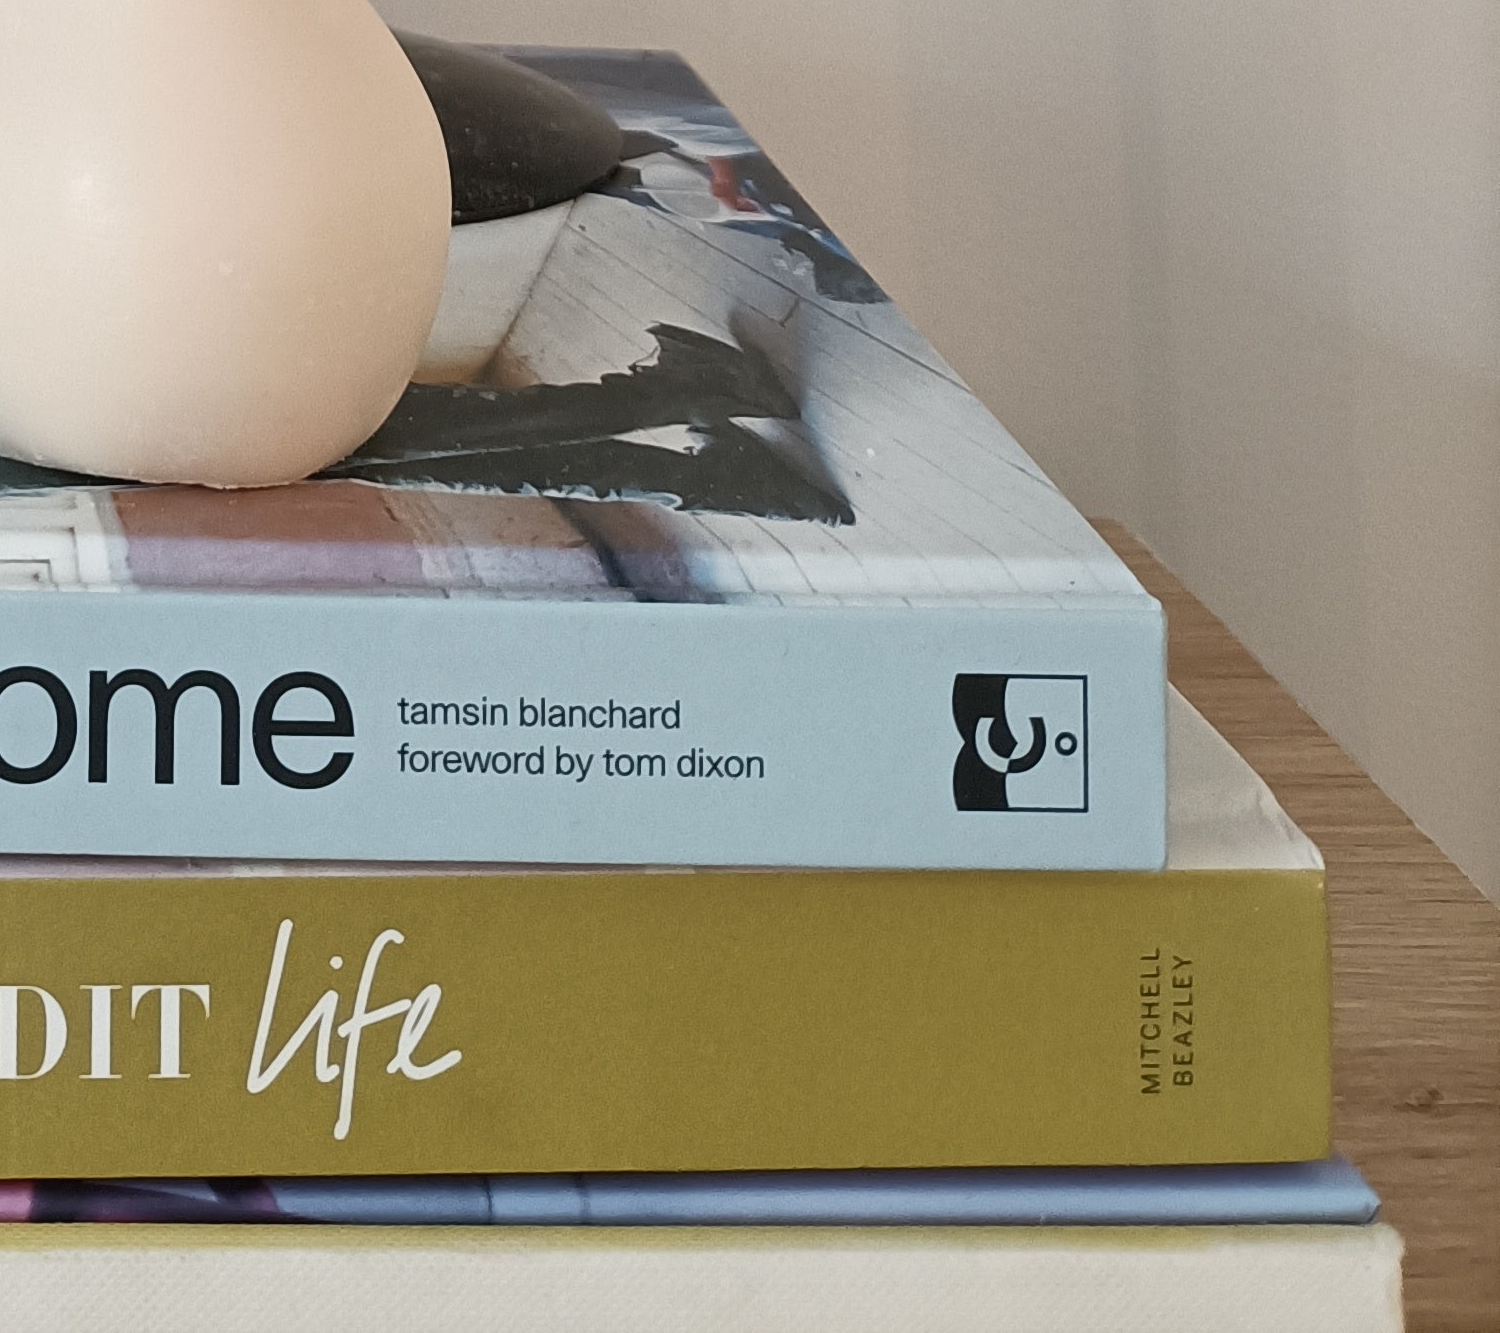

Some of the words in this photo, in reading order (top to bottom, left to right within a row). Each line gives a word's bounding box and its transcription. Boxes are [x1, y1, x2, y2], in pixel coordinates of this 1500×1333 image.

[396, 695, 509, 728] tamsin
[518, 696, 681, 730] blanchard
[396, 742, 545, 776] foreword
[555, 745, 594, 784] by
[601, 749, 666, 779] tom
[676, 747, 765, 781] dixon
[1139, 947, 1162, 1095] MITCHELL
[1171, 954, 1195, 1087] BEAZLEY
